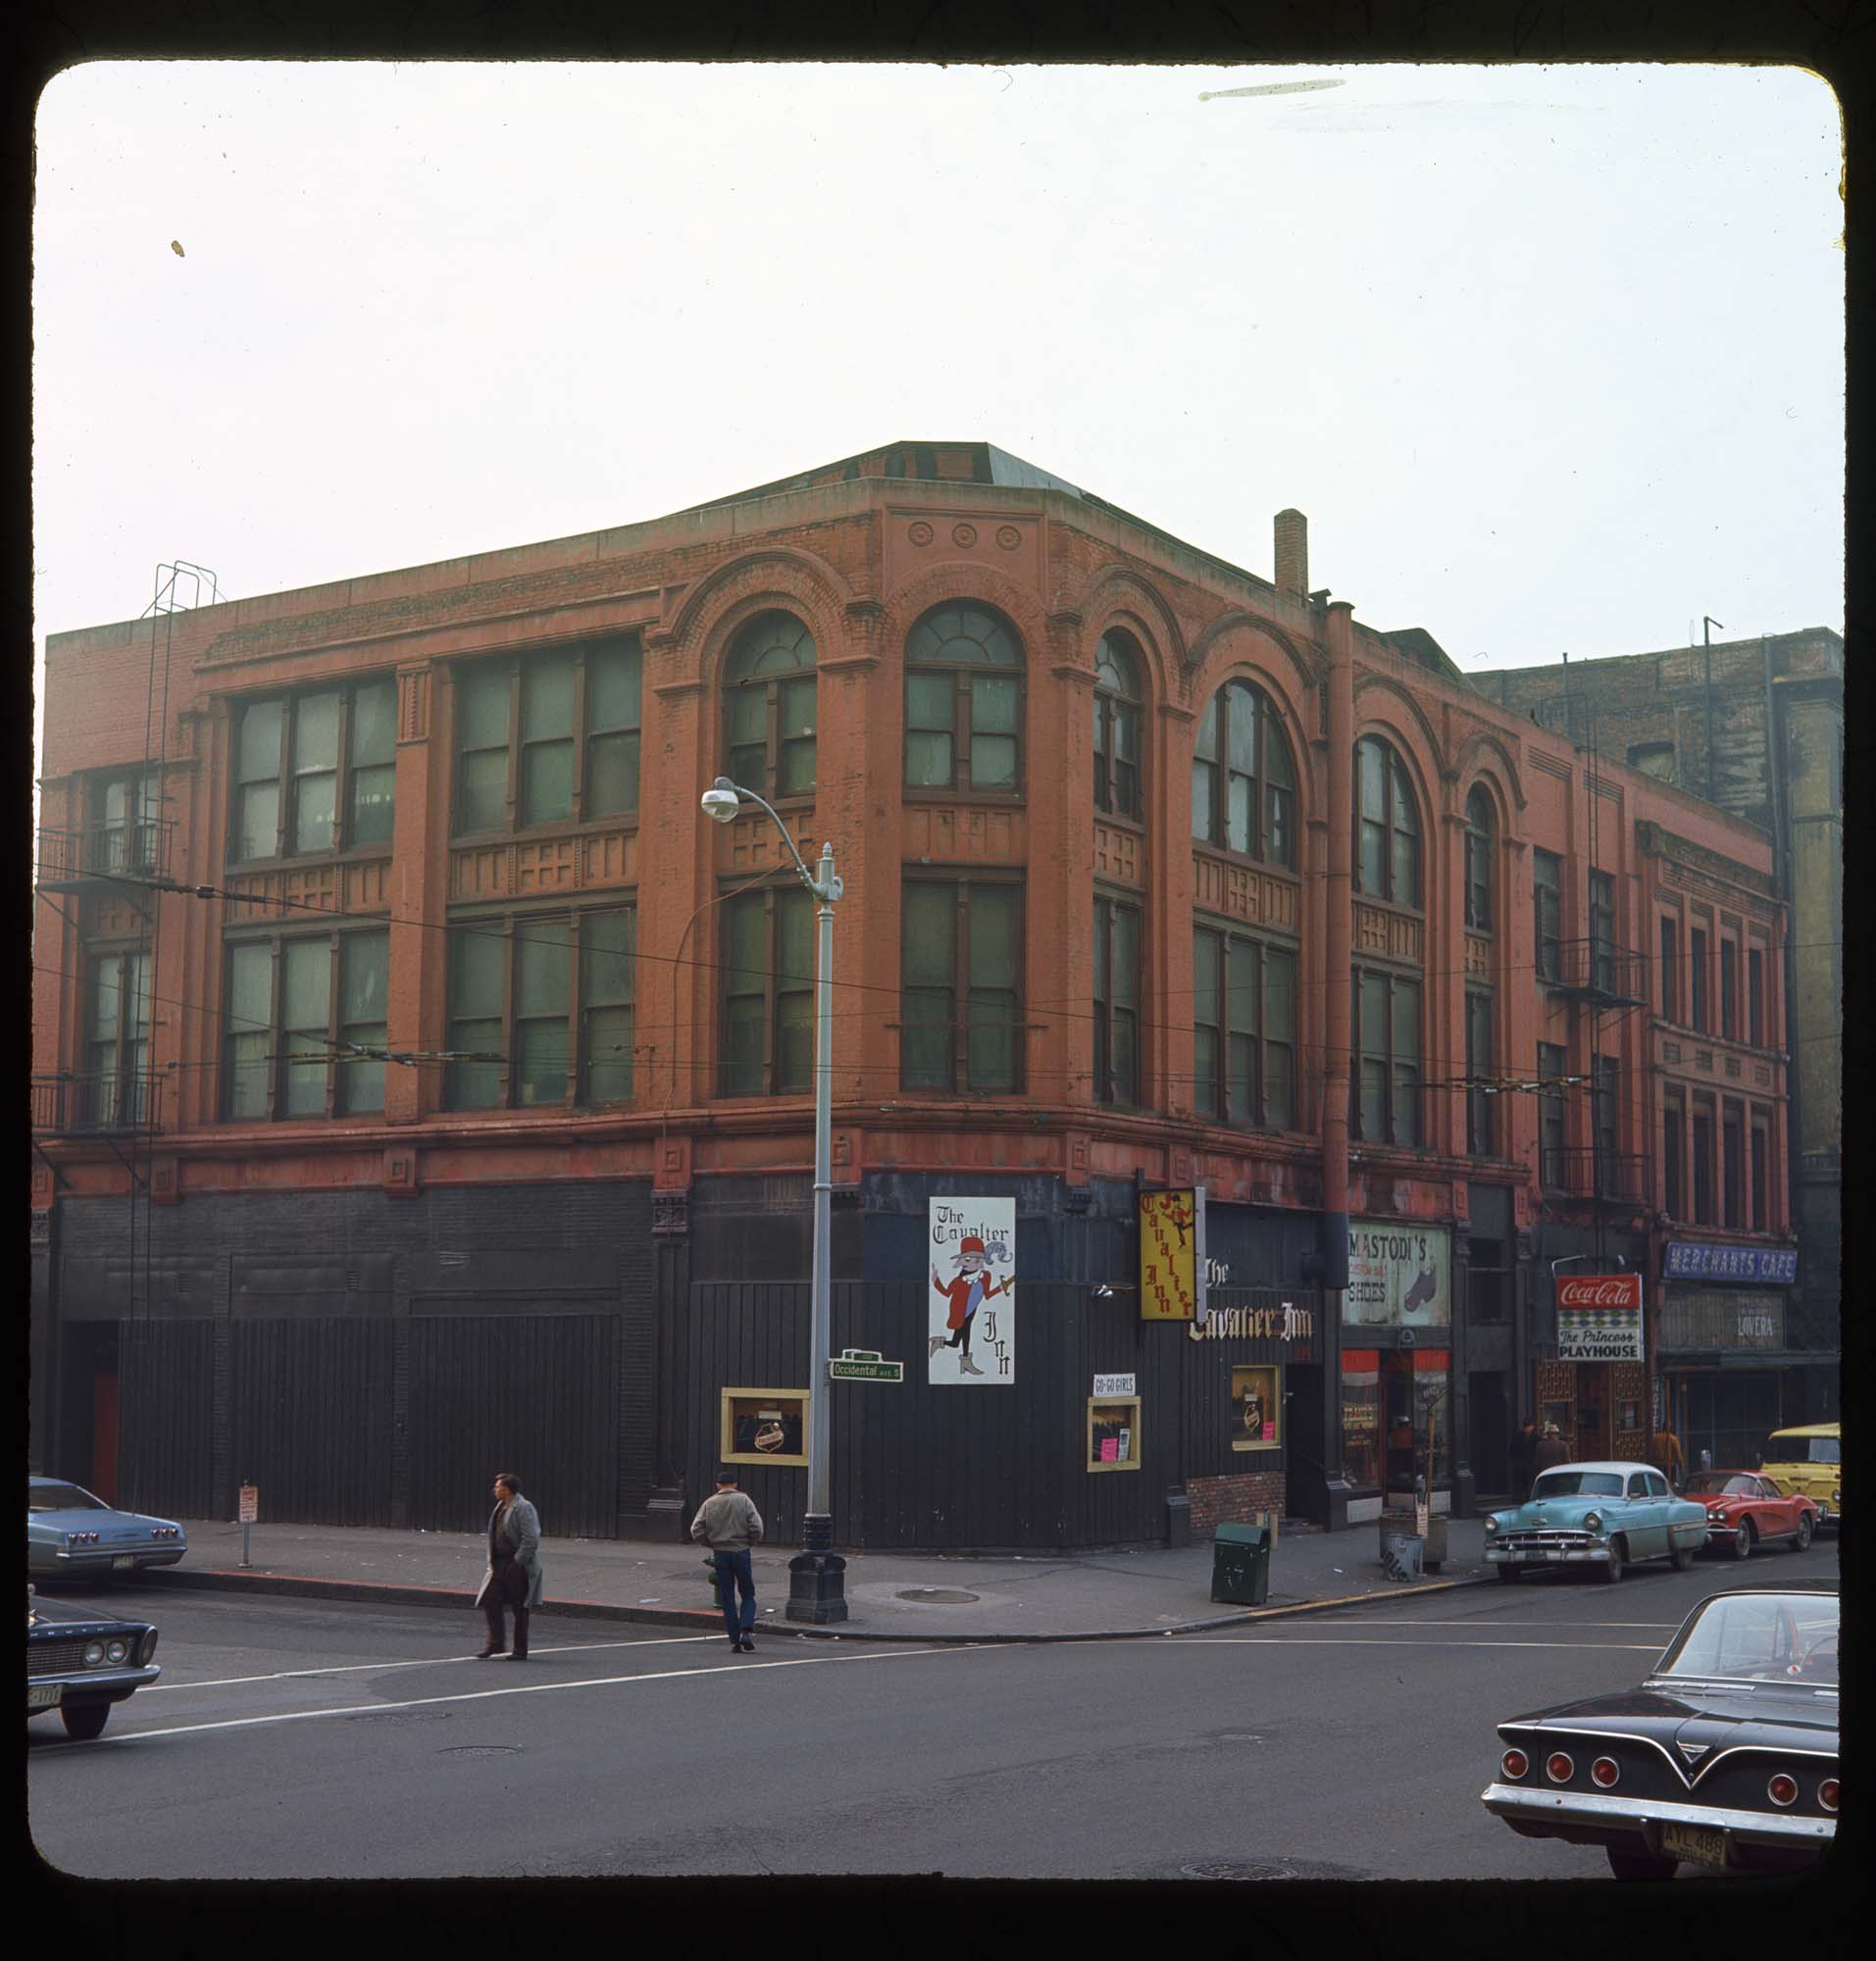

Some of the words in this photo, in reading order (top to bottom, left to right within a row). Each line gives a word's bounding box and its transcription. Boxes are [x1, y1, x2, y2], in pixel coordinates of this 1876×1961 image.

[937, 1206, 964, 1224] The
[933, 1223, 1009, 1244] Cavalier
[1141, 1193, 1192, 1317] Cavalier
[1670, 1247, 1756, 1274] MERCHANTS
[1761, 1254, 1794, 1278] CAFE
[1145, 1265, 1171, 1313] Inn
[1348, 1282, 1386, 1303] SHOES
[1560, 1281, 1633, 1305] Coca-Cola
[1281, 1302, 1312, 1341] Inn
[984, 1311, 1010, 1375] Inn
[1560, 1330, 1579, 1344] The
[1583, 1330, 1634, 1342] Princess
[1559, 1345, 1638, 1358] PLAYHOUSE
[835, 1363, 878, 1377] Occidental
[1095, 1378, 1115, 1392] GO-GO
[1116, 1378, 1134, 1392] GIRLS
